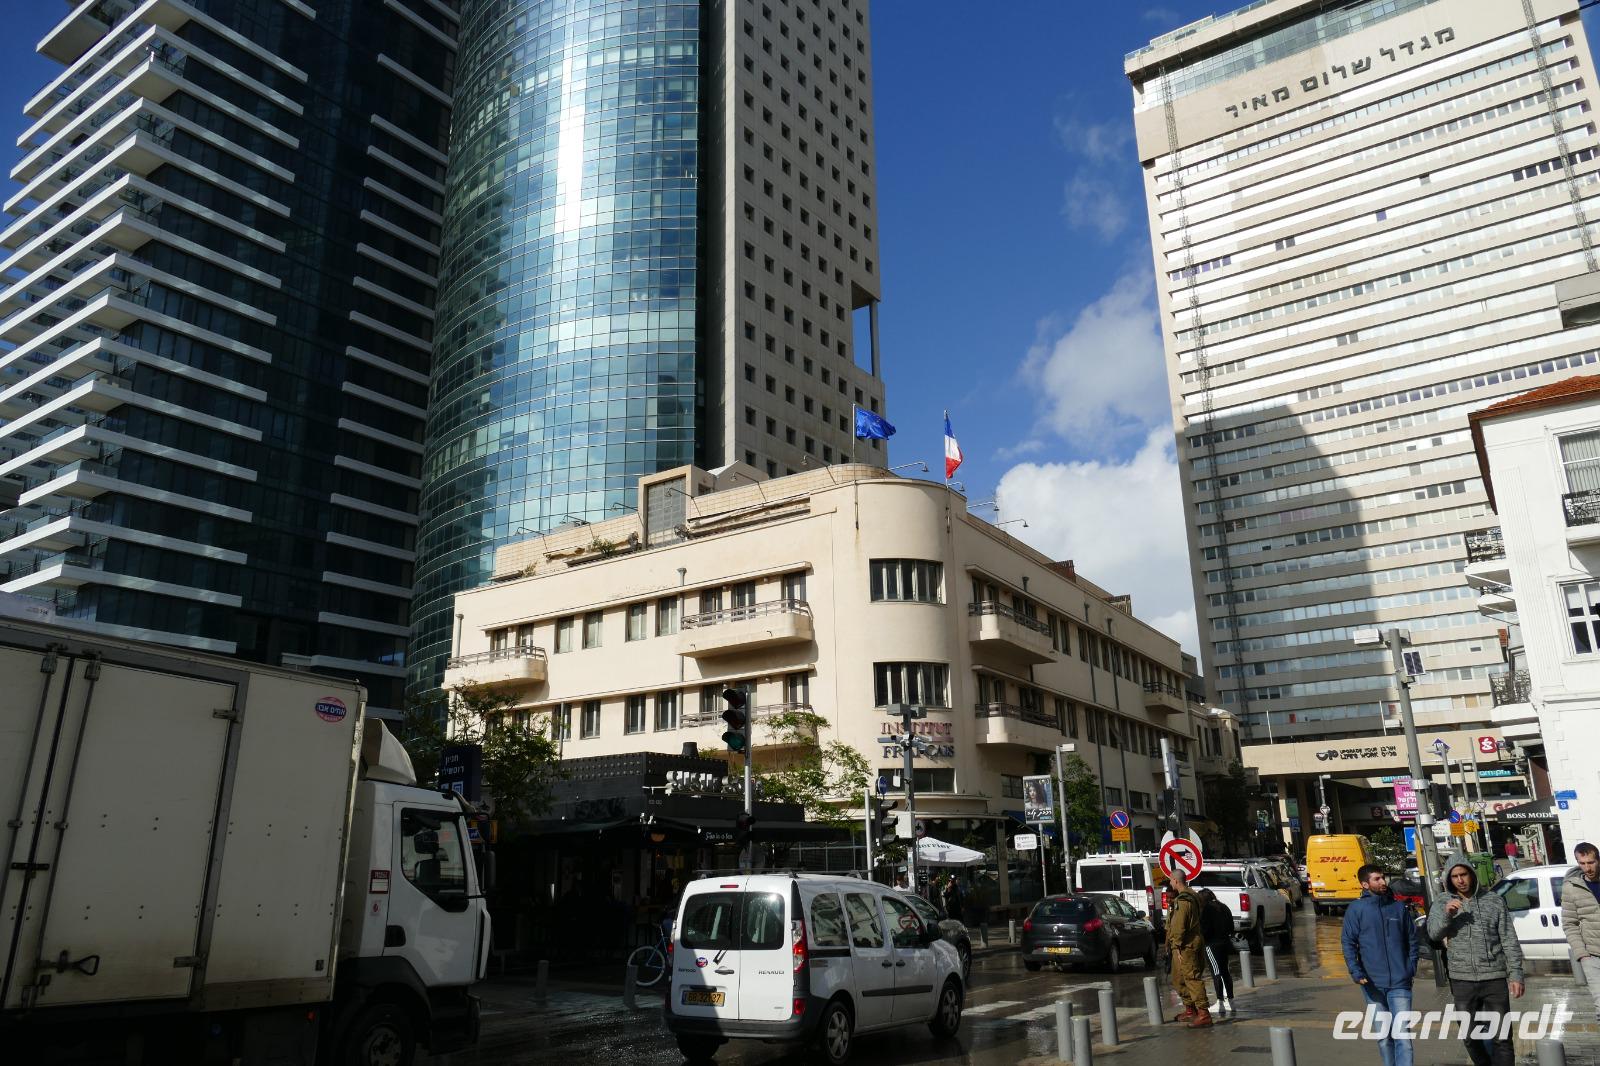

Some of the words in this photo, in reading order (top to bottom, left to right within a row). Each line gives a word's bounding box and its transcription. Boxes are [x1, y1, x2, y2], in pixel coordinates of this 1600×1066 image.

[1379, 25, 1456, 63] מגדל
[1300, 55, 1372, 92] שלום
[1224, 86, 1292, 119] מאיר
[1319, 856, 1350, 864] DHL
